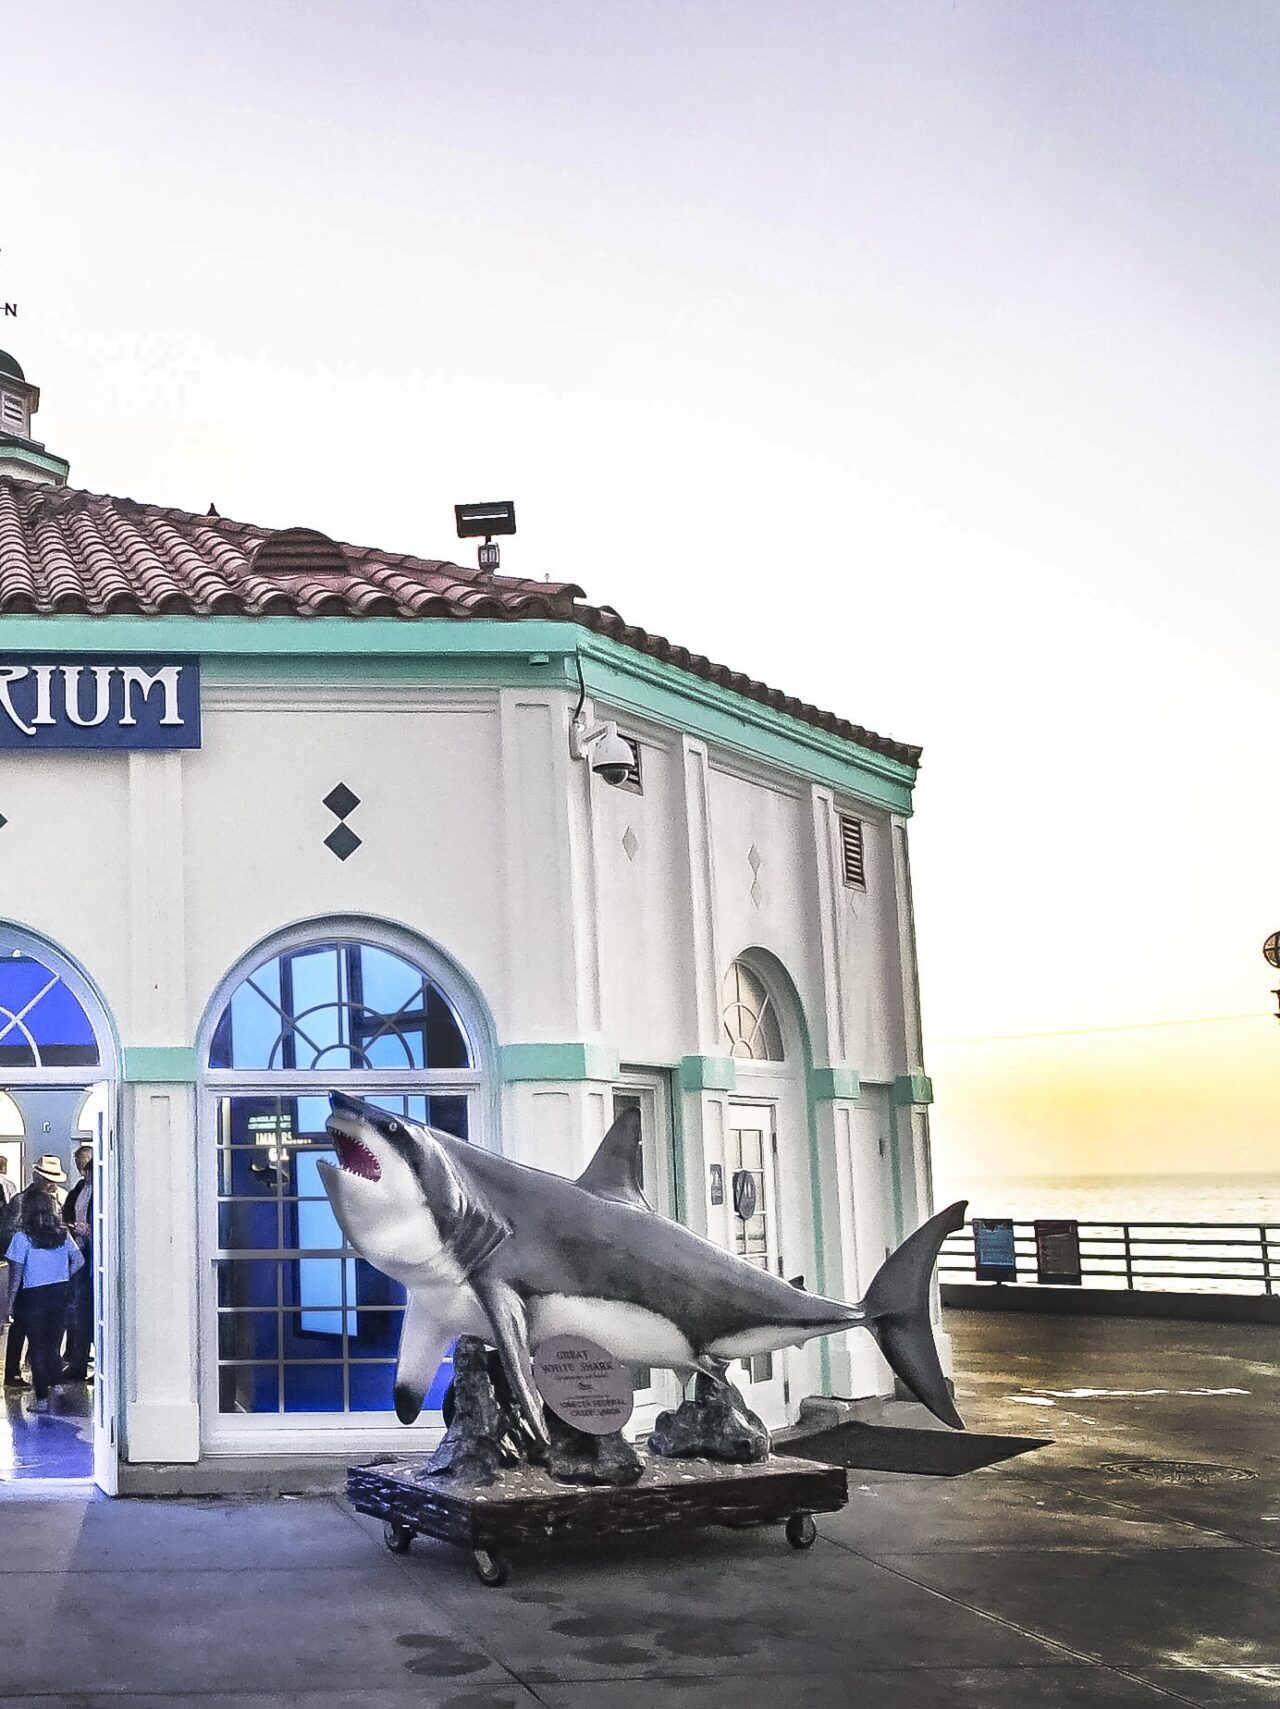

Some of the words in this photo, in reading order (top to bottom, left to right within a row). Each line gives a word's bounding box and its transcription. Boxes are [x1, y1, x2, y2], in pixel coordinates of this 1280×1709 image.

[5, 302, 17, 317] N
[556, 1350, 589, 1360] GREAT
[540, 1362, 575, 1374] WHITE
[579, 1361, 614, 1372] SHARK
